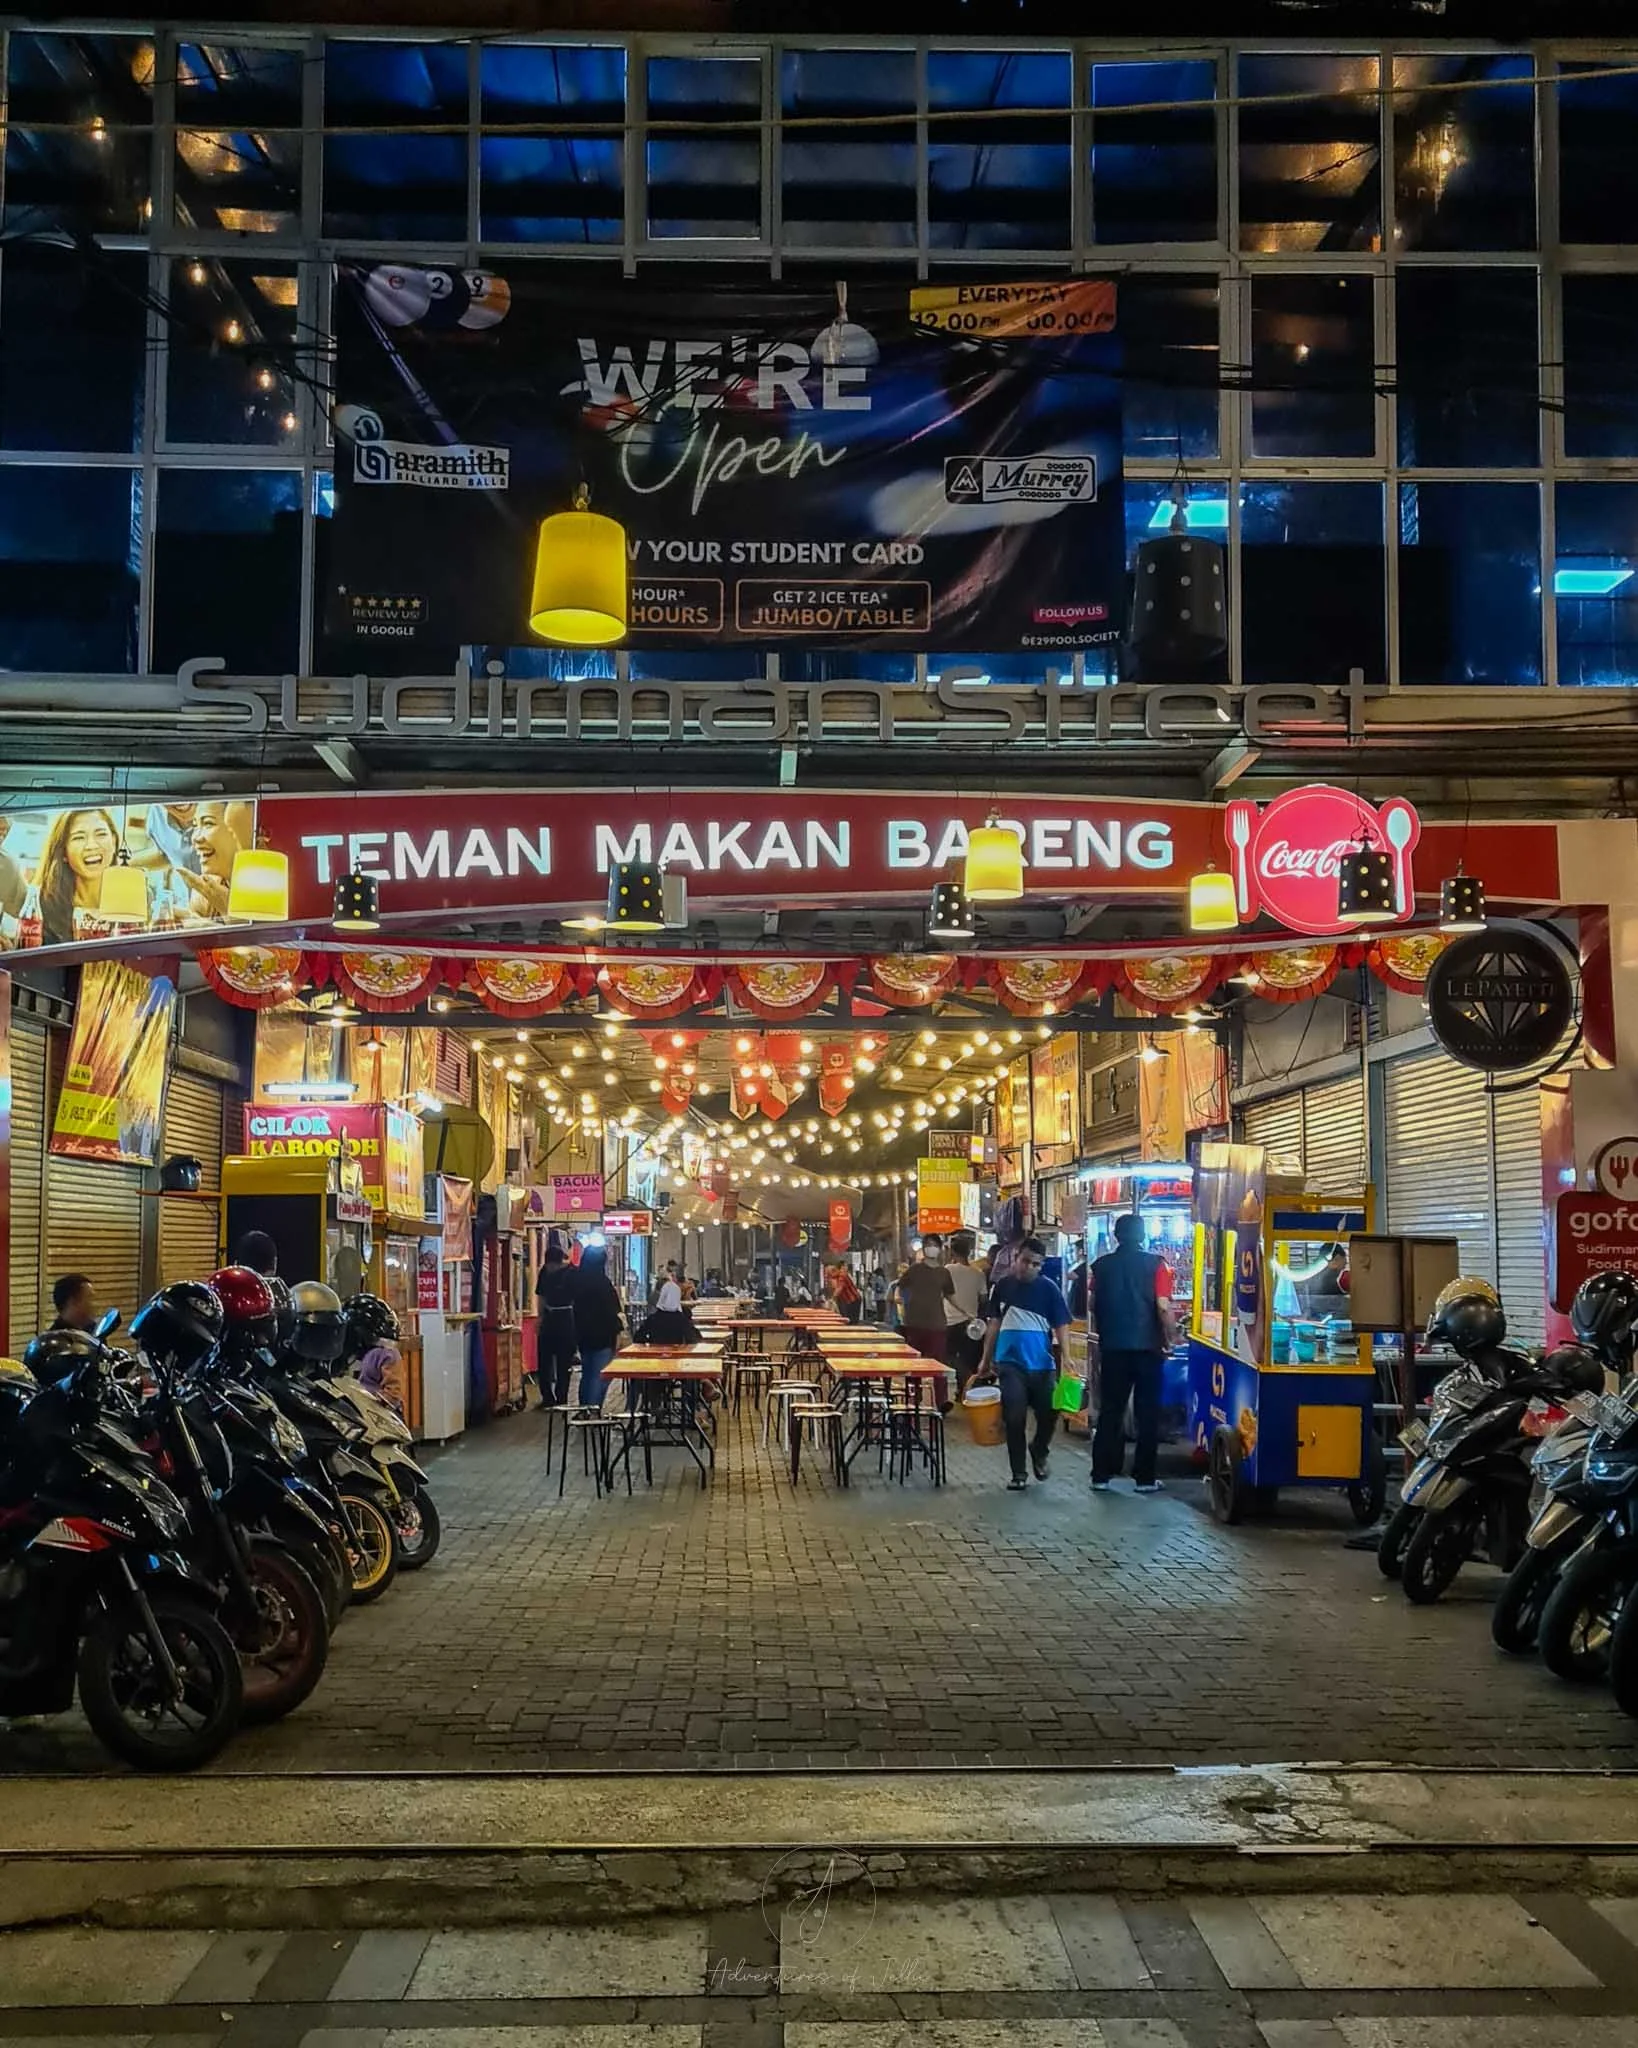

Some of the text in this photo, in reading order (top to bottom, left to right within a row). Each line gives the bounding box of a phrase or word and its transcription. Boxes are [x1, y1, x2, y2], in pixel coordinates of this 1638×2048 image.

[958, 286, 1067, 304] EVERYDAY
[576, 334, 873, 411] WE'RE
[394, 448, 507, 476] aramith
[621, 392, 848, 516] Open
[396, 471, 507, 487] BILLIARD BALLS
[987, 462, 1089, 497] Murrey
[647, 540, 723, 563] YOUR
[730, 541, 846, 565] STUDENT
[852, 542, 925, 566] CARD
[773, 590, 803, 604] GET
[808, 591, 817, 604] 2
[821, 591, 847, 605] ICE
[352, 607, 398, 619] REVIEW
[631, 606, 709, 624] HOURS
[751, 607, 915, 630] JUMBO/TABLE
[1039, 605, 1103, 619] FOLLOW US
[356, 624, 415, 636] IN GOOGLE
[176, 656, 1388, 748] Sudirman Street
[301, 827, 552, 884] TEMAN
[595, 820, 850, 875] MAKAN
[250, 1116, 332, 1136] CILOK
[554, 1175, 601, 1188] BACUK
[1587, 1259, 1622, 1270] Food
[101, 1517, 136, 1539] HONDA
